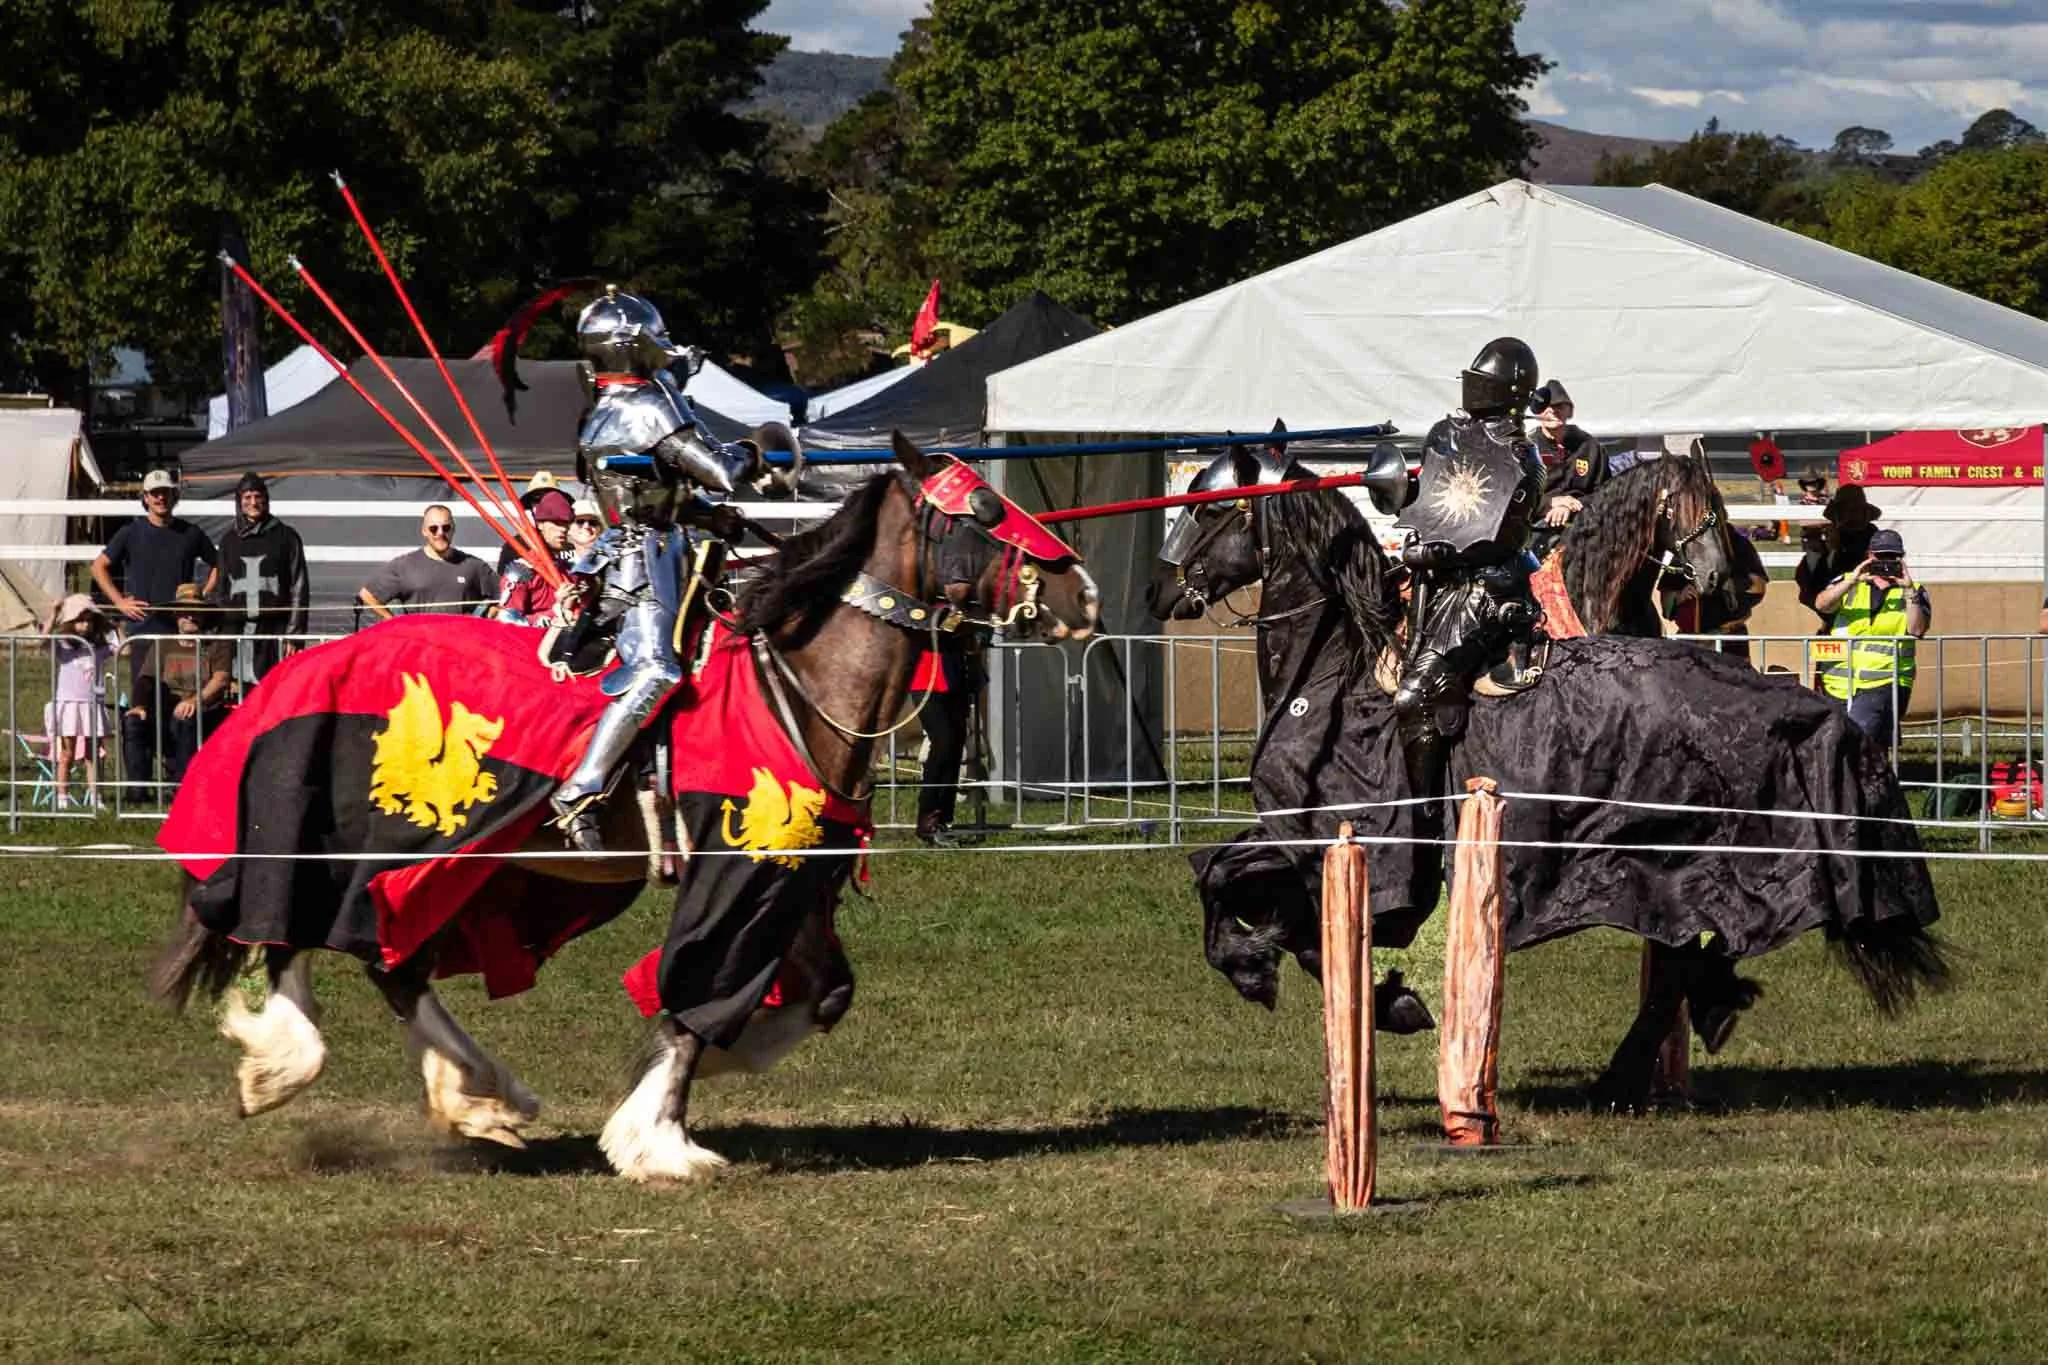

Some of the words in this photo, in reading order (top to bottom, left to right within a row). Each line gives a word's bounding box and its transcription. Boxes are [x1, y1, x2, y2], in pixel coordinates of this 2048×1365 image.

[1881, 465, 1913, 479] YOUR
[1919, 465, 1961, 479] FAMILY
[1967, 465, 2004, 479] CREST
[2014, 465, 2024, 479] &
[1815, 643, 1841, 655] TFH
